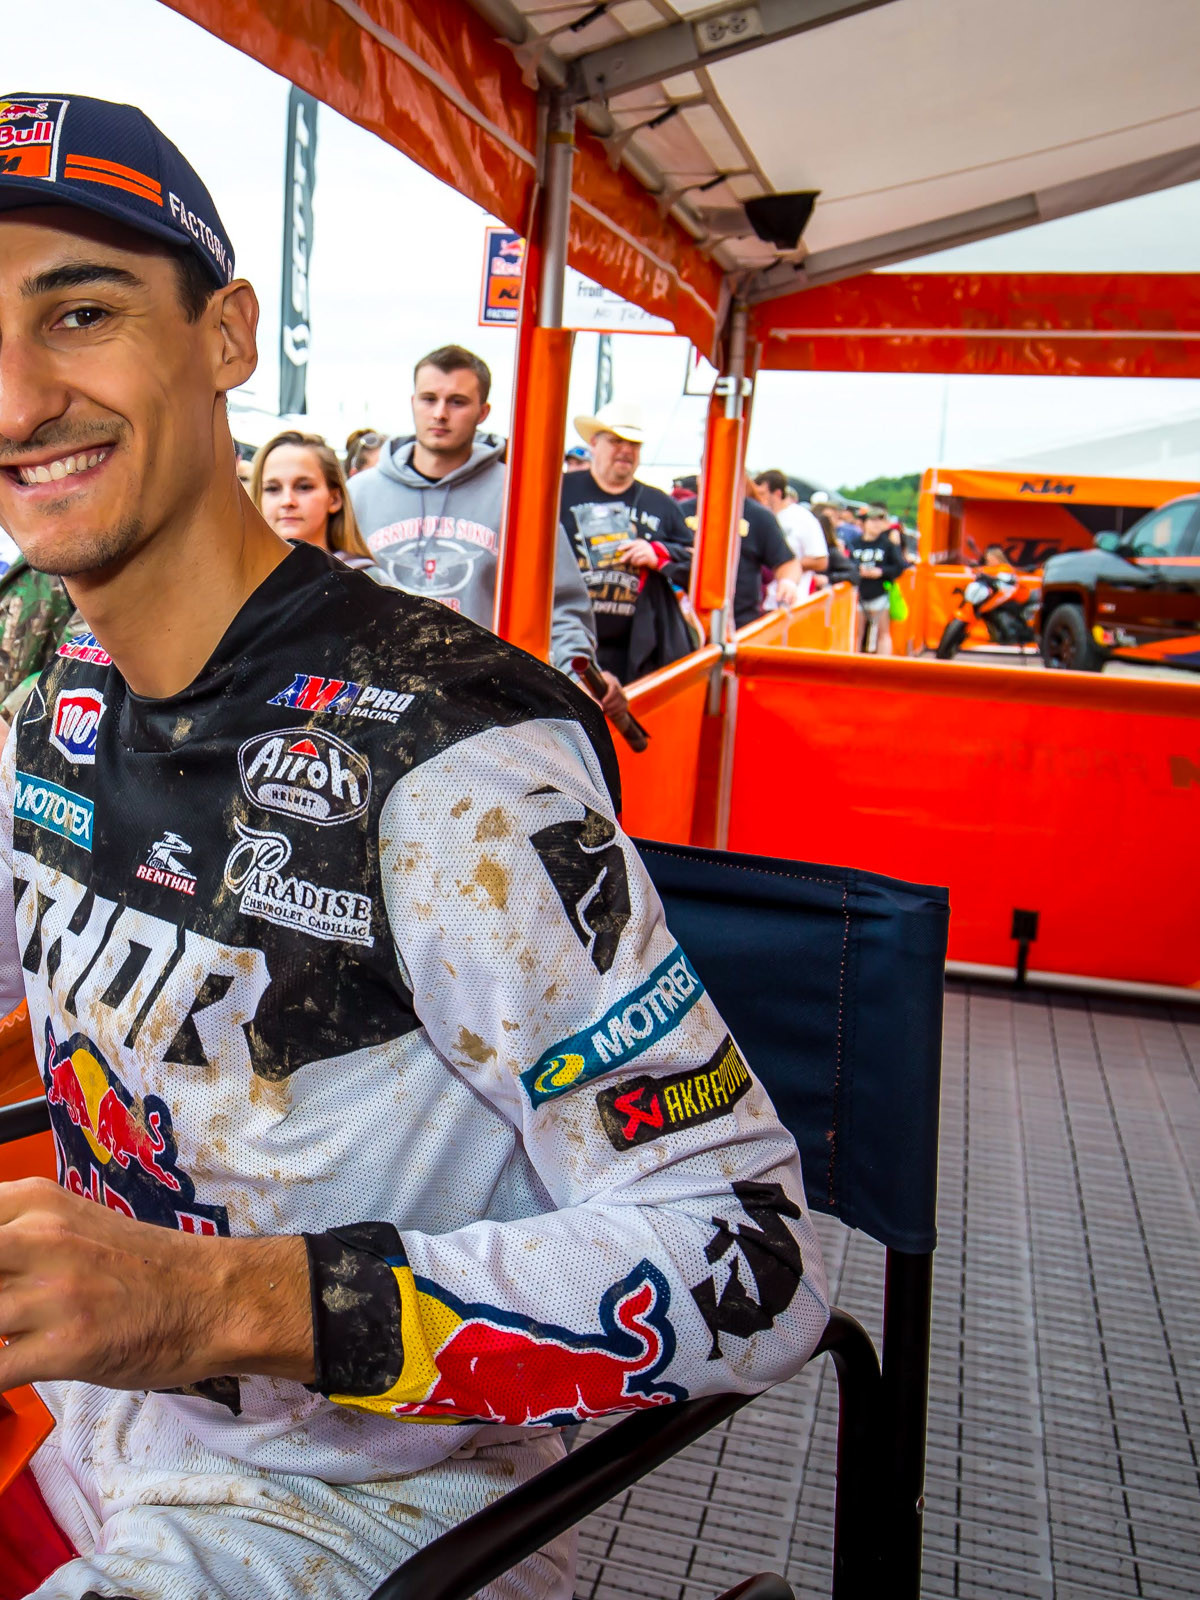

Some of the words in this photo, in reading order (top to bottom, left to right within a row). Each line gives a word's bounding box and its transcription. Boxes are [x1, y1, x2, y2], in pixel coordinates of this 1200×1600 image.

[168, 191, 227, 273] FACTORY
[266, 673, 362, 716] AMA
[357, 686, 416, 713] PRO
[351, 706, 400, 724] RACING
[246, 737, 361, 806] Airoh
[14, 779, 93, 841] MOTOREX
[271, 790, 316, 809] HELMET
[136, 864, 197, 896] RENTHAL
[243, 895, 303, 922] CHEVROLET
[308, 915, 367, 937] CADILLAC
